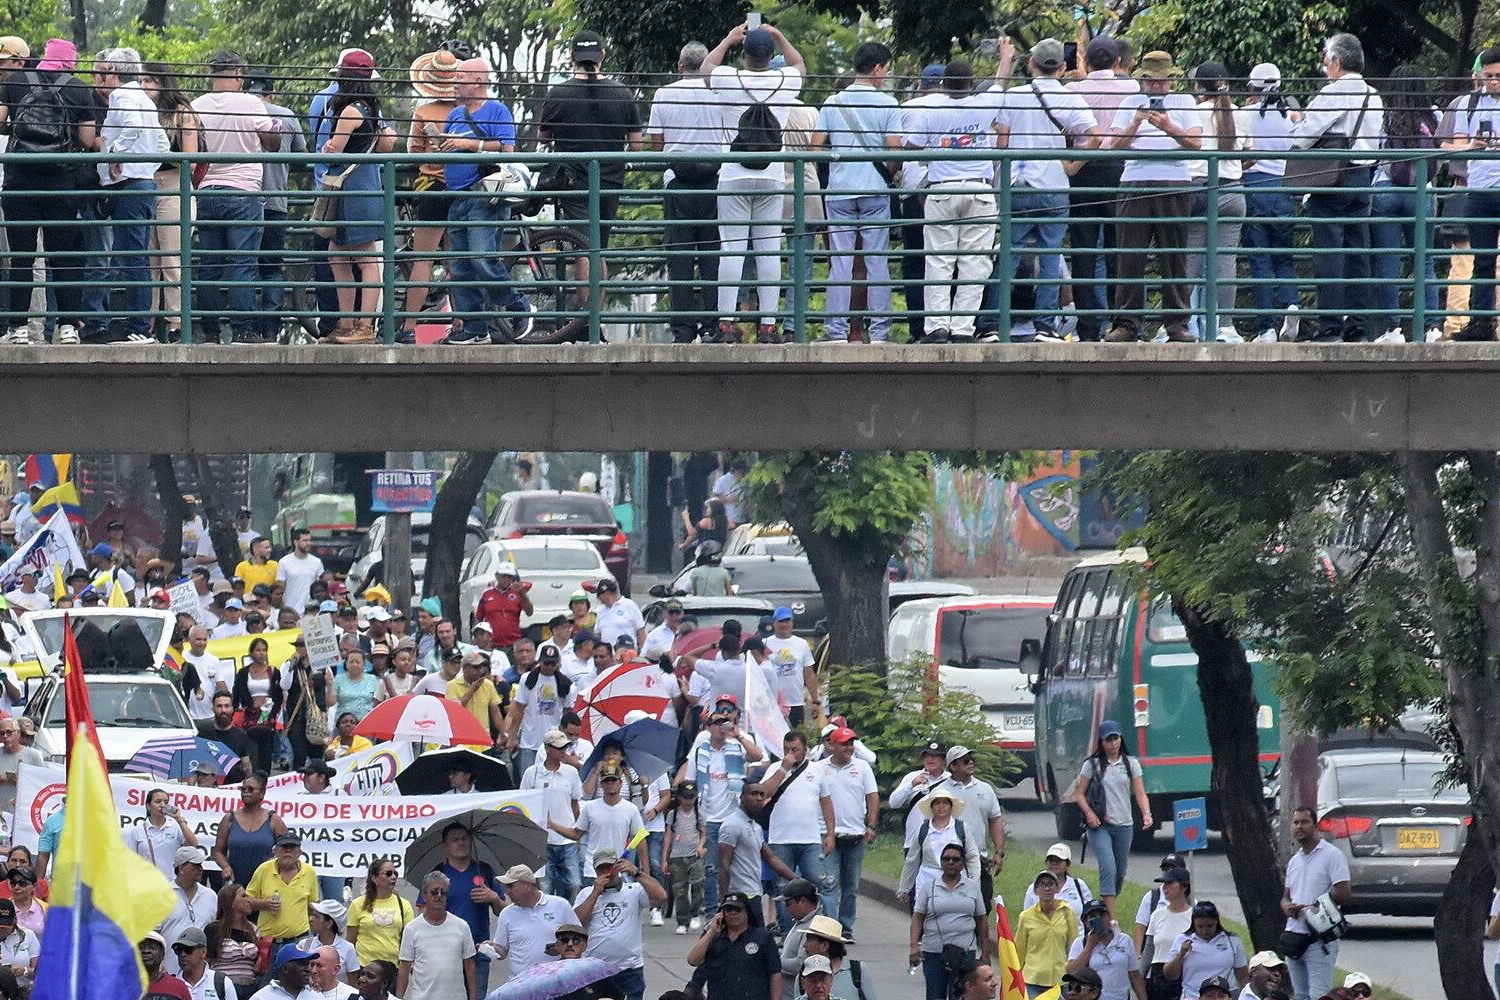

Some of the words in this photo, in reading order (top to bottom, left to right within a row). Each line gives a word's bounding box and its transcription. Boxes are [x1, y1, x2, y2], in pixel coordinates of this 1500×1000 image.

[412, 473, 432, 486] TUS
[324, 803, 351, 819] DE
[358, 804, 436, 819] YUMBO
[194, 822, 219, 836] AS
[340, 852, 404, 869] CAMB
